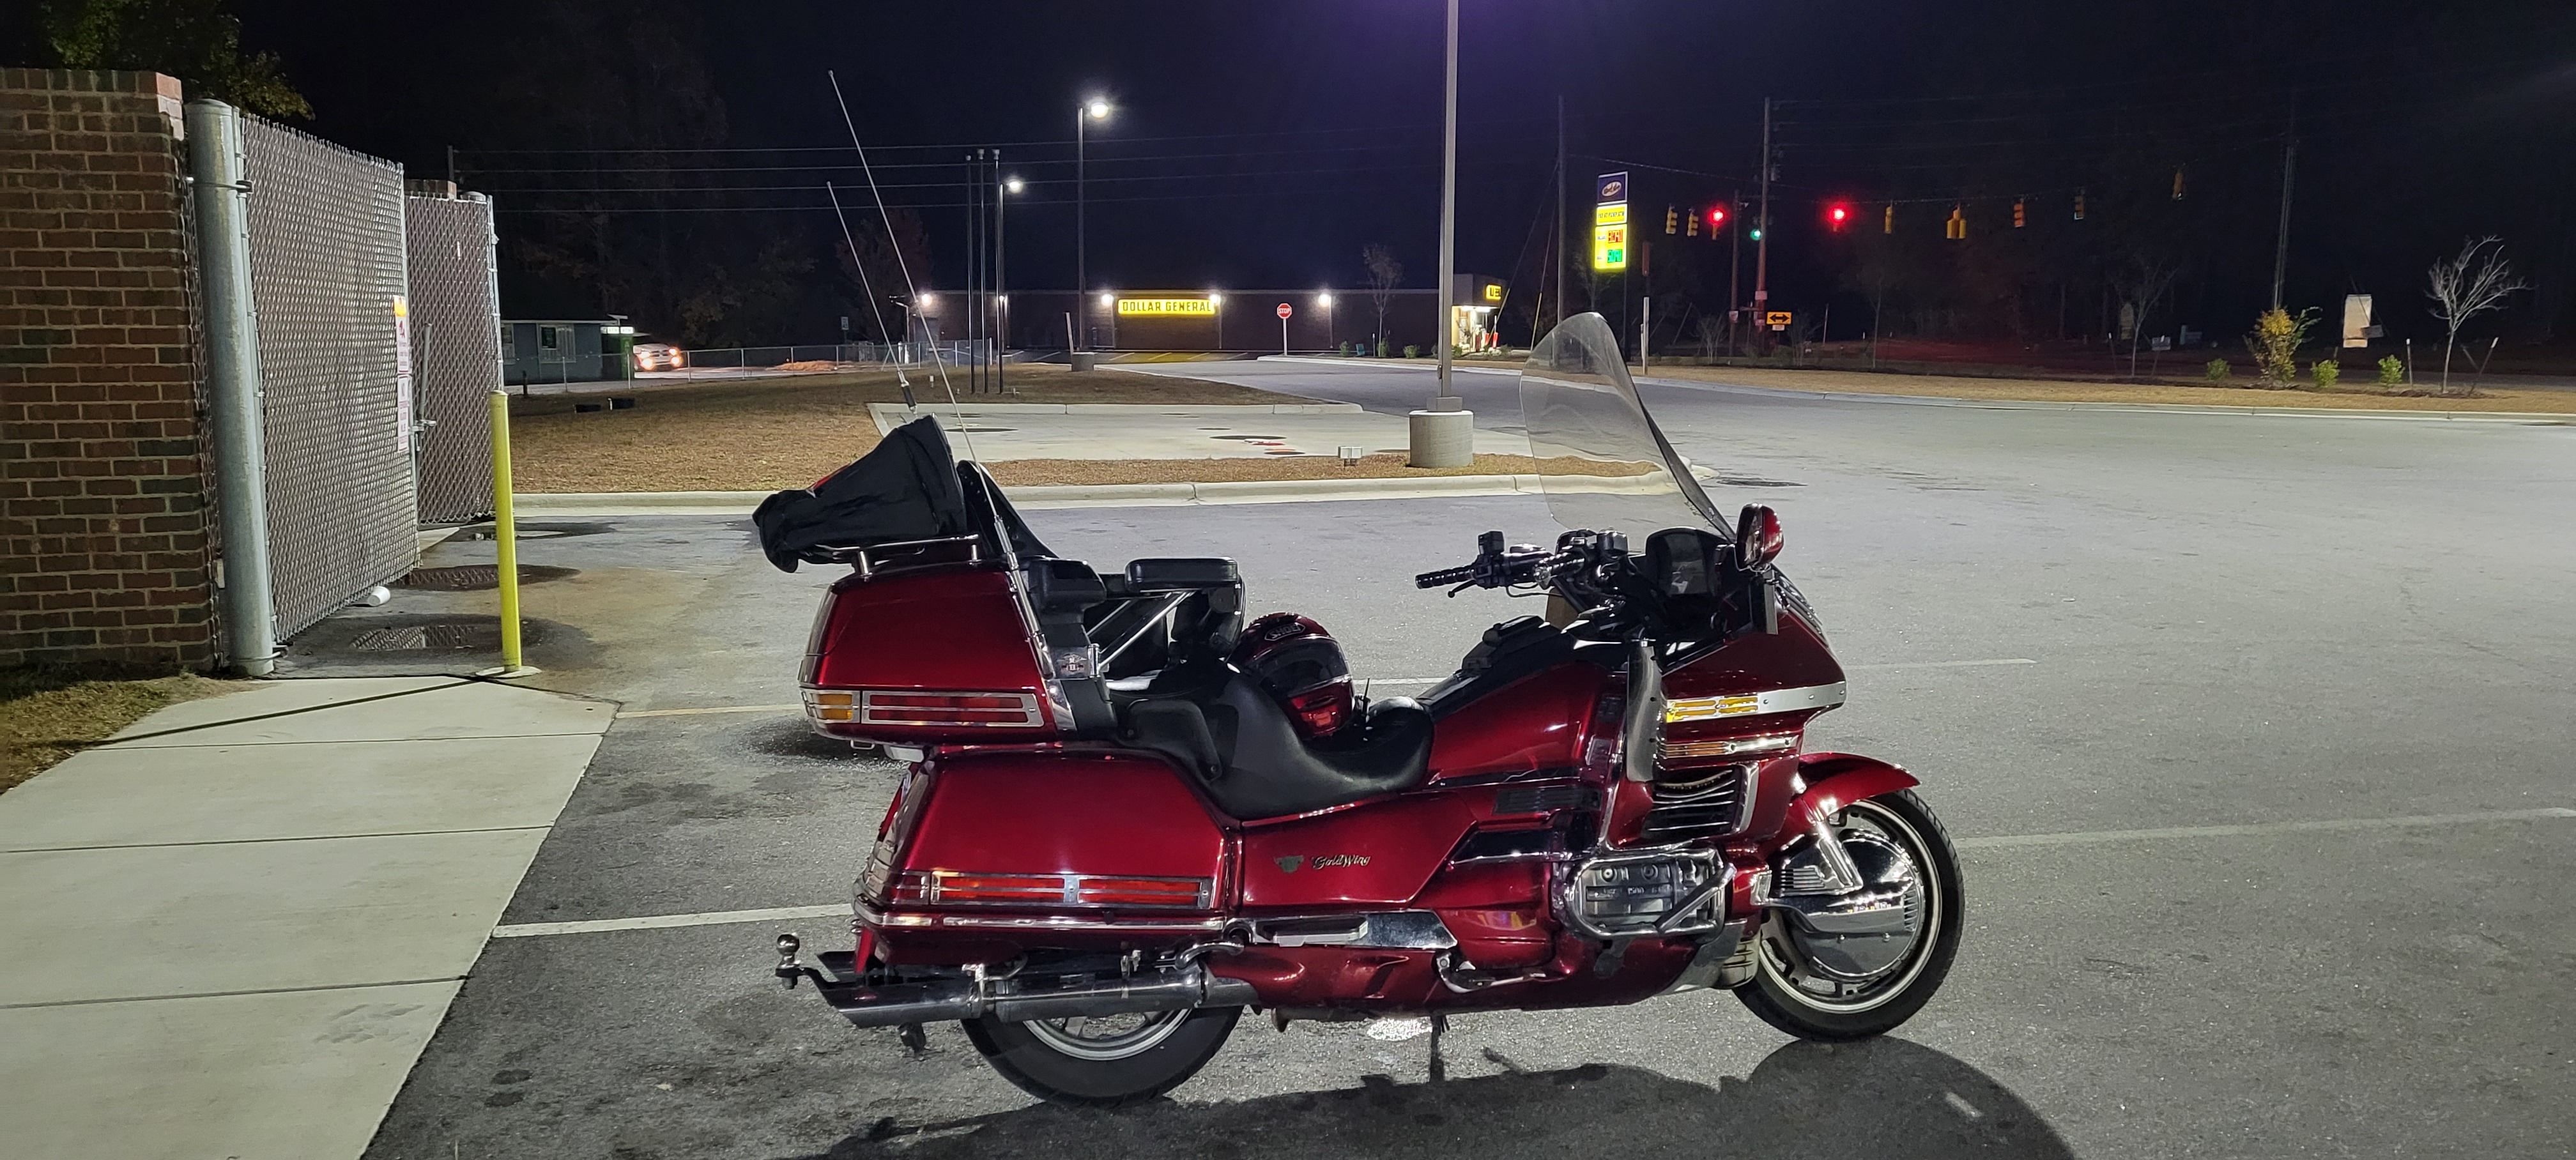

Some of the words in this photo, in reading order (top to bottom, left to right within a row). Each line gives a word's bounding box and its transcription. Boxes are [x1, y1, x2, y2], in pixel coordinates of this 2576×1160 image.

[1123, 301, 1161, 311] DOLLAR
[1166, 301, 1211, 311] GENERAL
[1269, 623, 1301, 639] SHOEI
